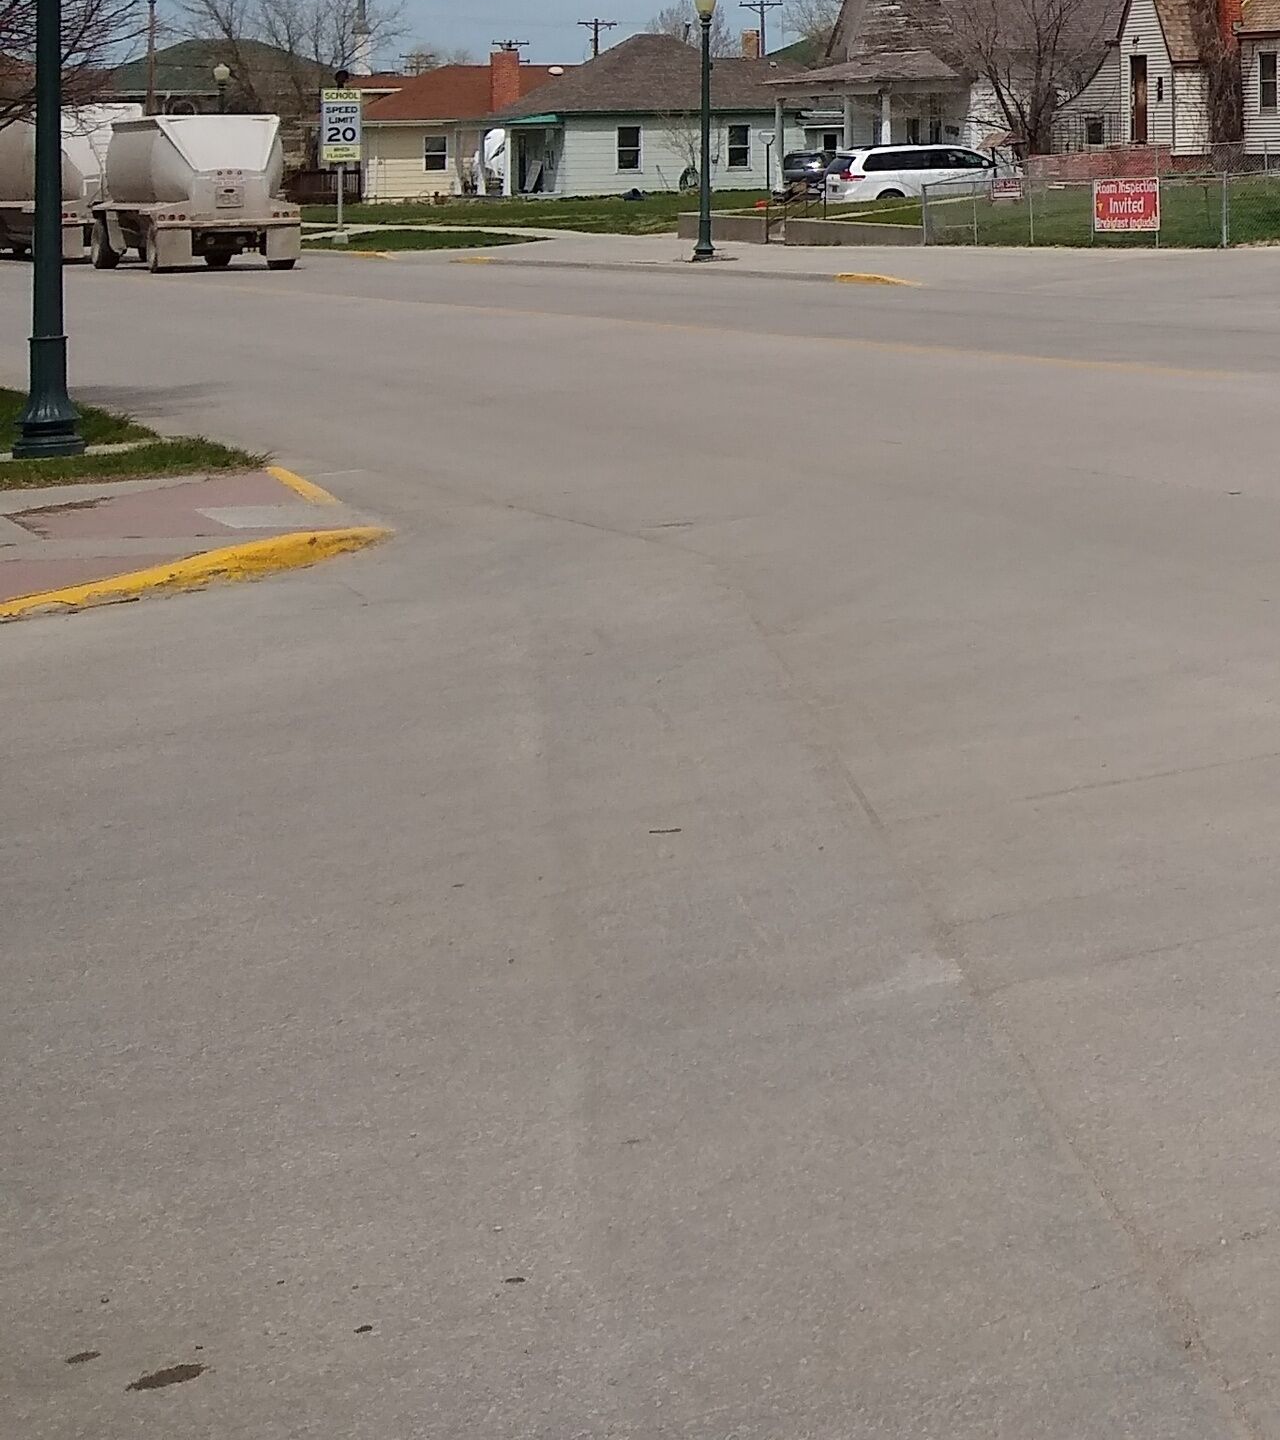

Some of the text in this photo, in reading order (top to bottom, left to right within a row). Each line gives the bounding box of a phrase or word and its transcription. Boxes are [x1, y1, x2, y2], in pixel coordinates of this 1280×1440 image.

[324, 92, 359, 100] SCHOOL
[325, 106, 358, 114] SPEED
[328, 116, 355, 124] LIMIT
[327, 127, 356, 142] 20
[1095, 179, 1157, 196] Room Inspection
[1109, 197, 1145, 213] Invited
[1095, 216, 1128, 229] Breakfast
